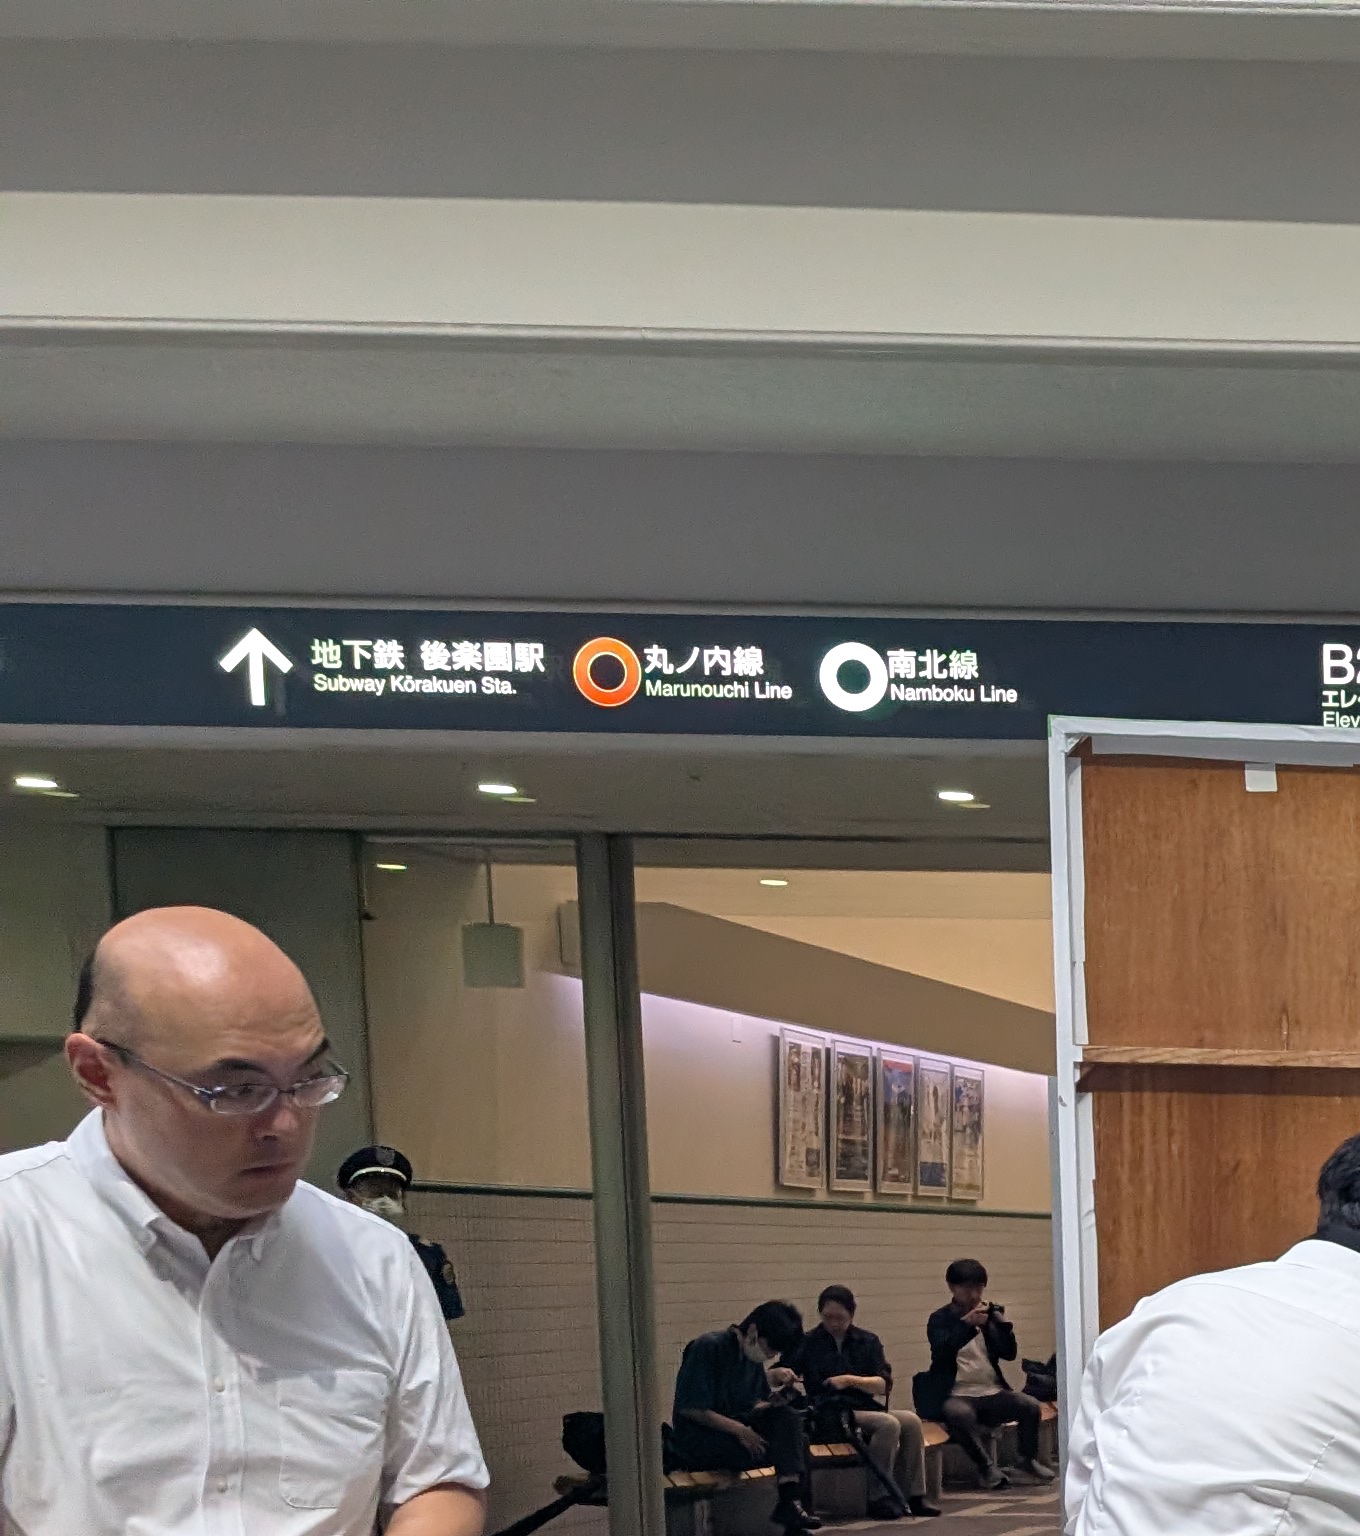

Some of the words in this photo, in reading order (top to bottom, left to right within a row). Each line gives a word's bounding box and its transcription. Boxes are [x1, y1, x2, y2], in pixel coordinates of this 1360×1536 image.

[311, 639, 405, 670] 地下鉄
[420, 640, 545, 673] 後楽園駅
[644, 644, 764, 677] 丸ノ内線
[887, 649, 979, 680] 南北線
[314, 674, 386, 696] Subway
[390, 675, 477, 694] Kōrakuen
[481, 676, 517, 695] Sta.
[645, 680, 750, 698] Marunouchi
[755, 681, 793, 699] Line
[890, 684, 975, 701] Namboku
[980, 685, 1018, 702] Line
